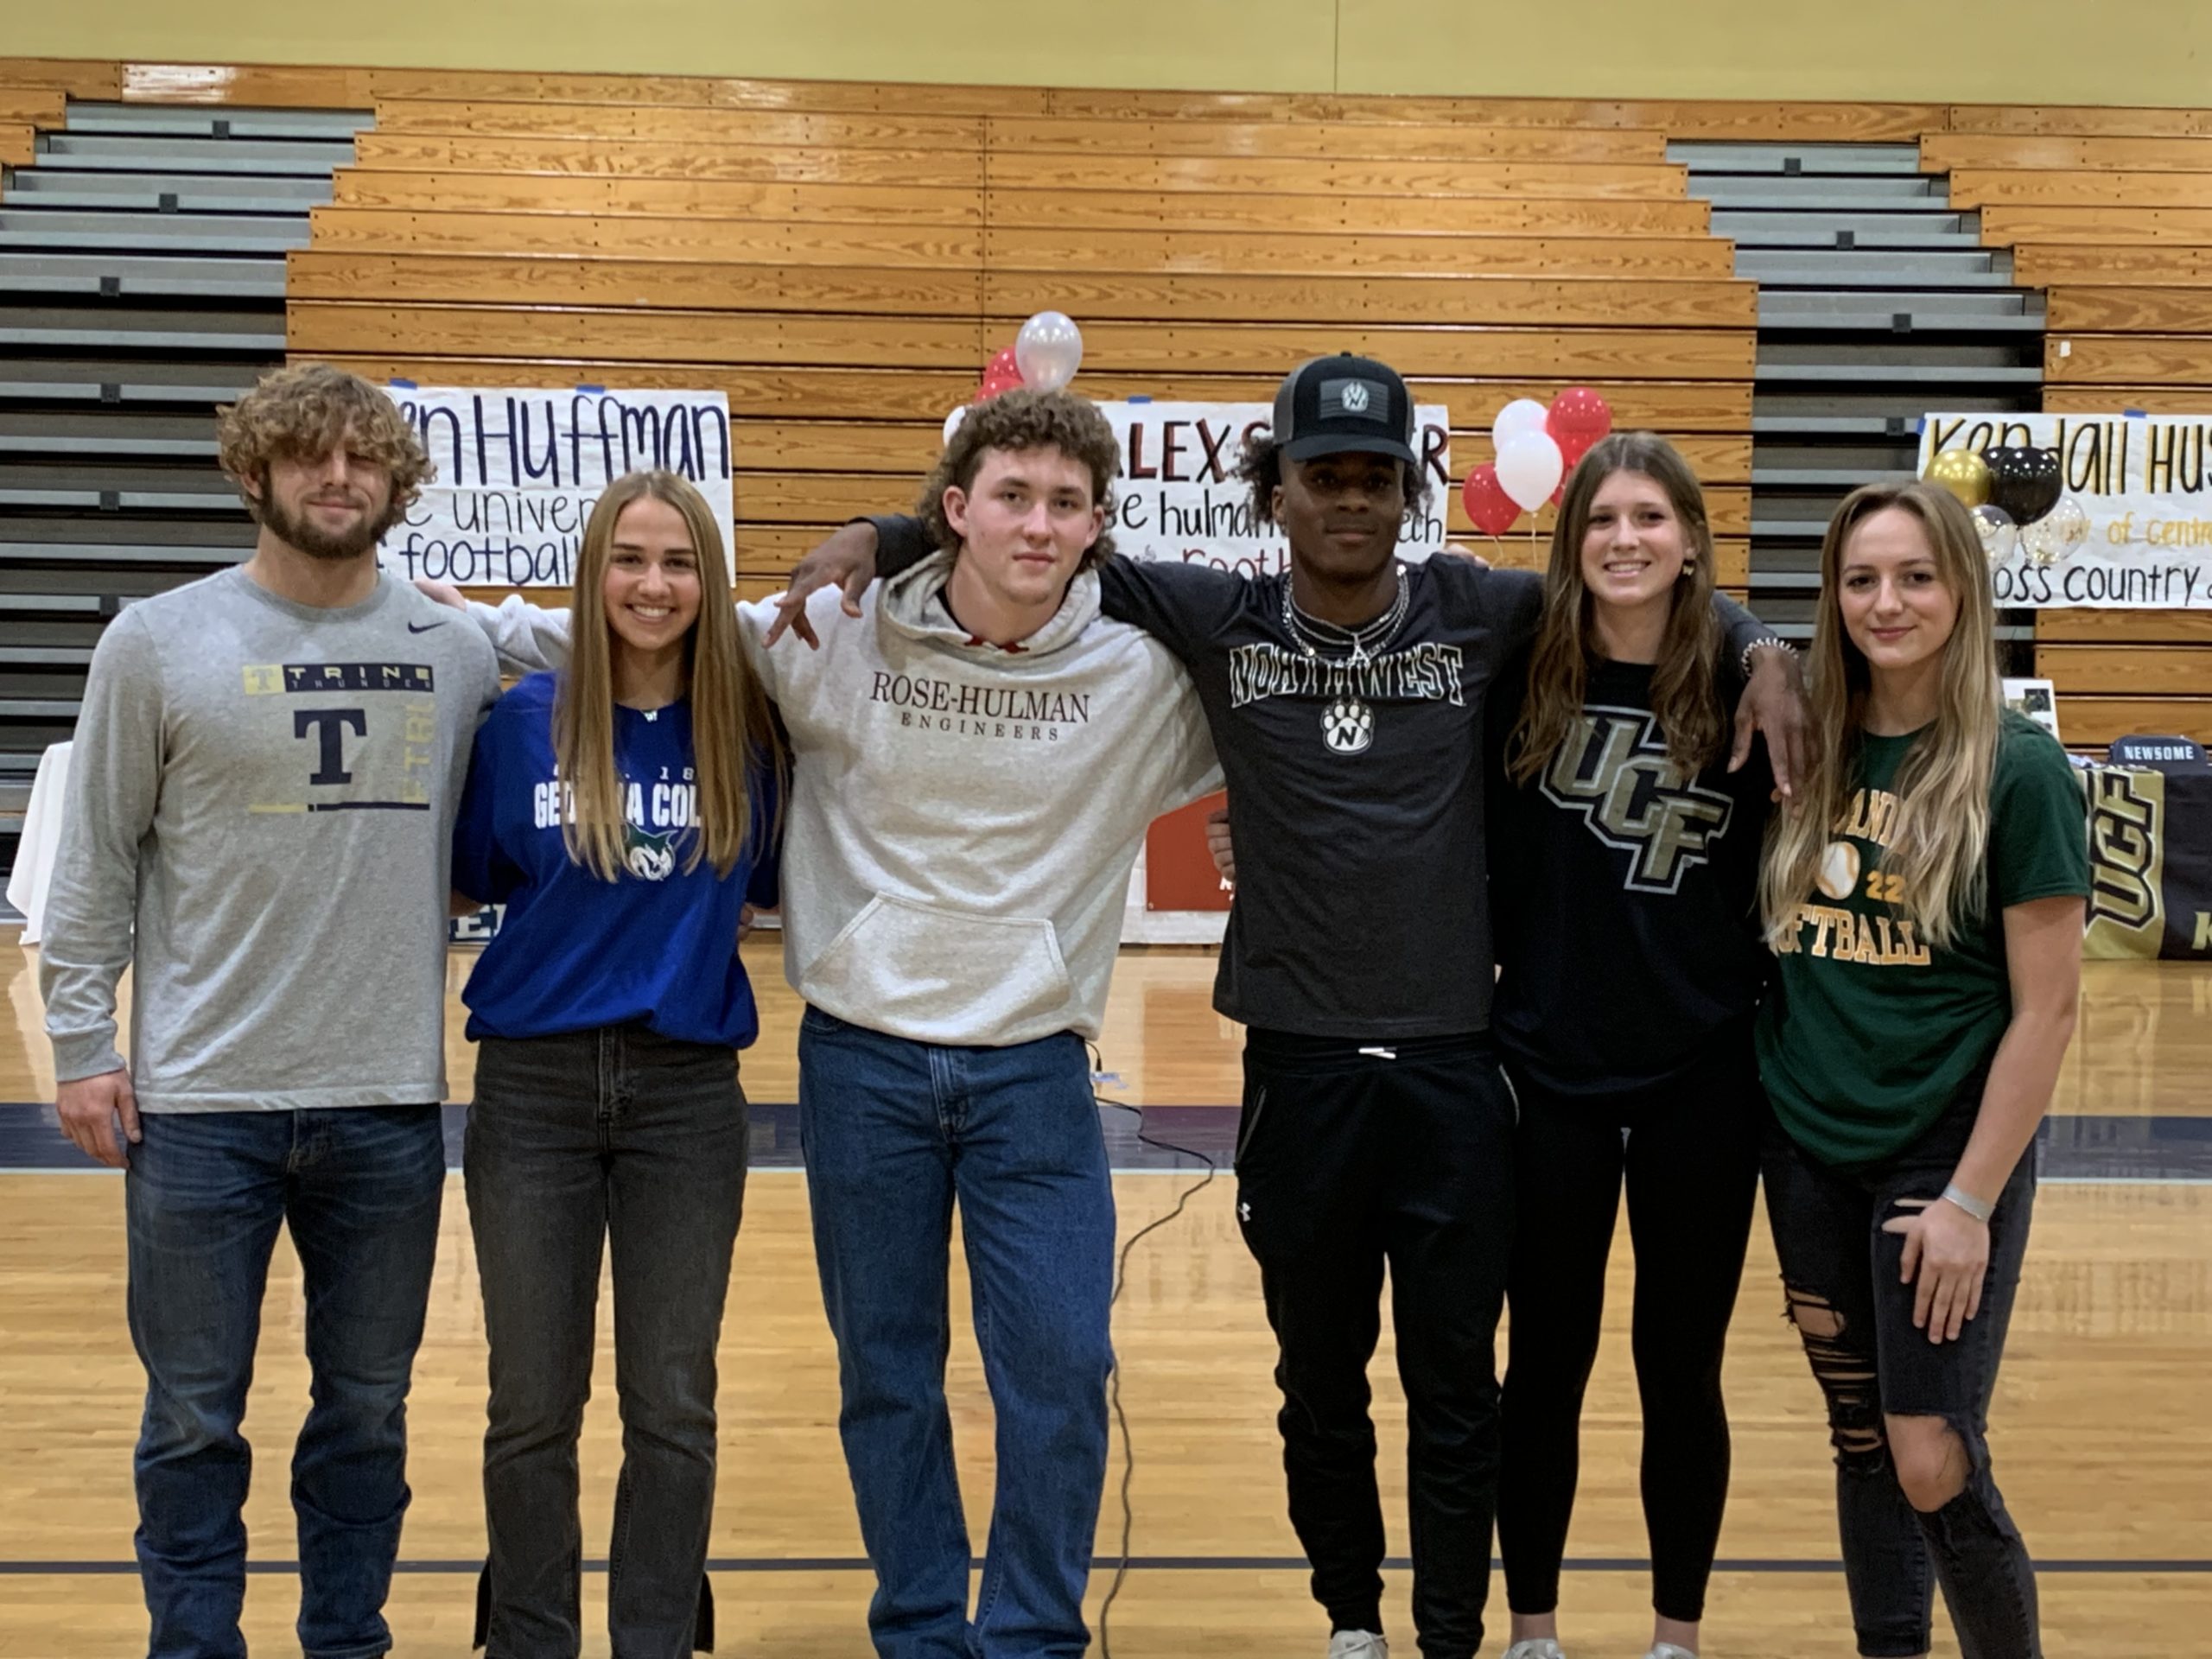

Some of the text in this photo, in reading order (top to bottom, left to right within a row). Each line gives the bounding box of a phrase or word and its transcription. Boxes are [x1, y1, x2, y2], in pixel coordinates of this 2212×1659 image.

[474, 394, 728, 487] Huffman
[1117, 418, 1230, 484] LEX
[2107, 512, 2135, 545] of
[1993, 564, 2051, 603] oss
[2063, 564, 2201, 607] country
[869, 671, 1090, 723] ROSE-HULMAN
[294, 709, 367, 785] T
[901, 711, 1058, 741] ENGINEERS
[2124, 745, 2195, 760] NEWSOME
[1539, 704, 1733, 894] UCF
[2084, 767, 2158, 940] UCF
[1866, 869, 1905, 905] 22
